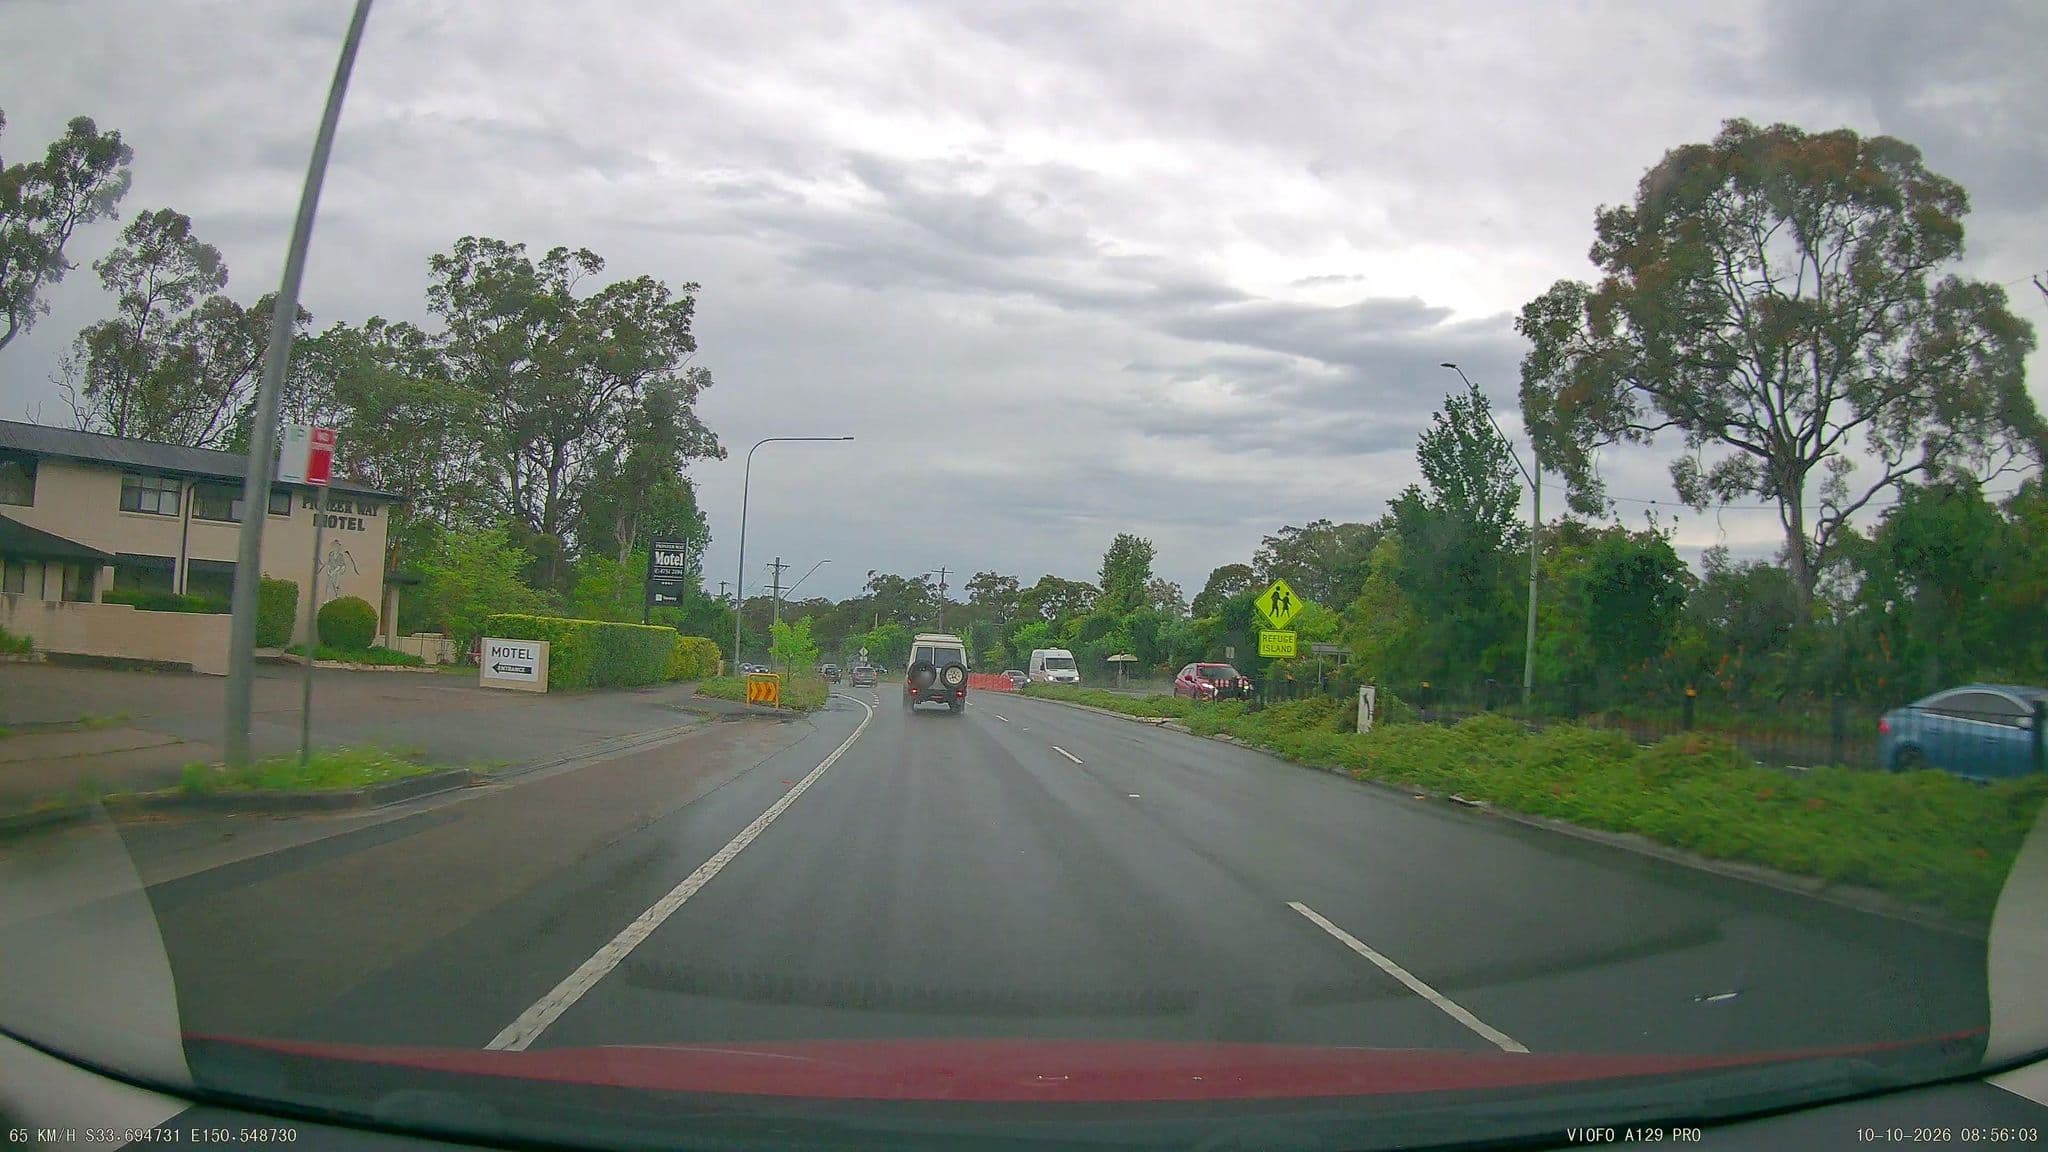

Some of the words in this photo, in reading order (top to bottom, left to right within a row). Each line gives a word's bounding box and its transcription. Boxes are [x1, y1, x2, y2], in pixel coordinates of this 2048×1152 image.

[655, 551, 684, 566] Motel
[1262, 634, 1294, 644] REFUGE
[491, 646, 534, 660] MOTEL
[1263, 644, 1292, 652] ISLAND
